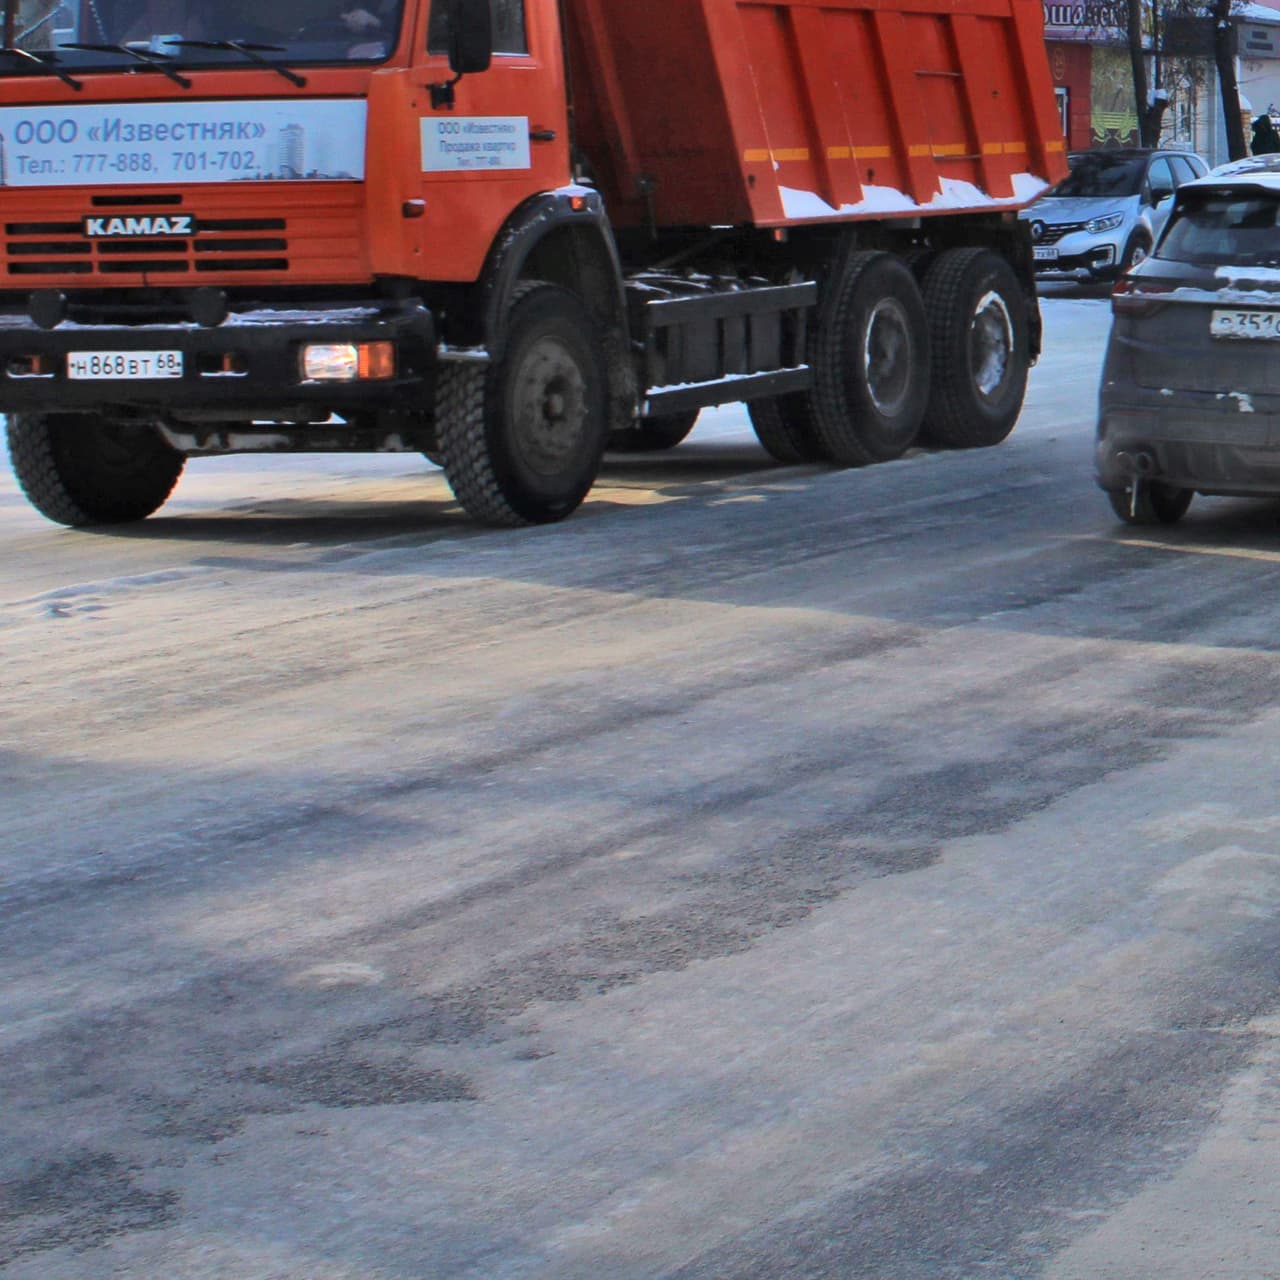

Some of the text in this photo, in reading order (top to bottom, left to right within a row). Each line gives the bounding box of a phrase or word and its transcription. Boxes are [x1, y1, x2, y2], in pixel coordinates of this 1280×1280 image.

[15, 117, 266, 145] ООО «Известняк»
[16, 150, 262, 174] Тел.: 777-888, 701-702.
[86, 216, 192, 236] KAMAZ
